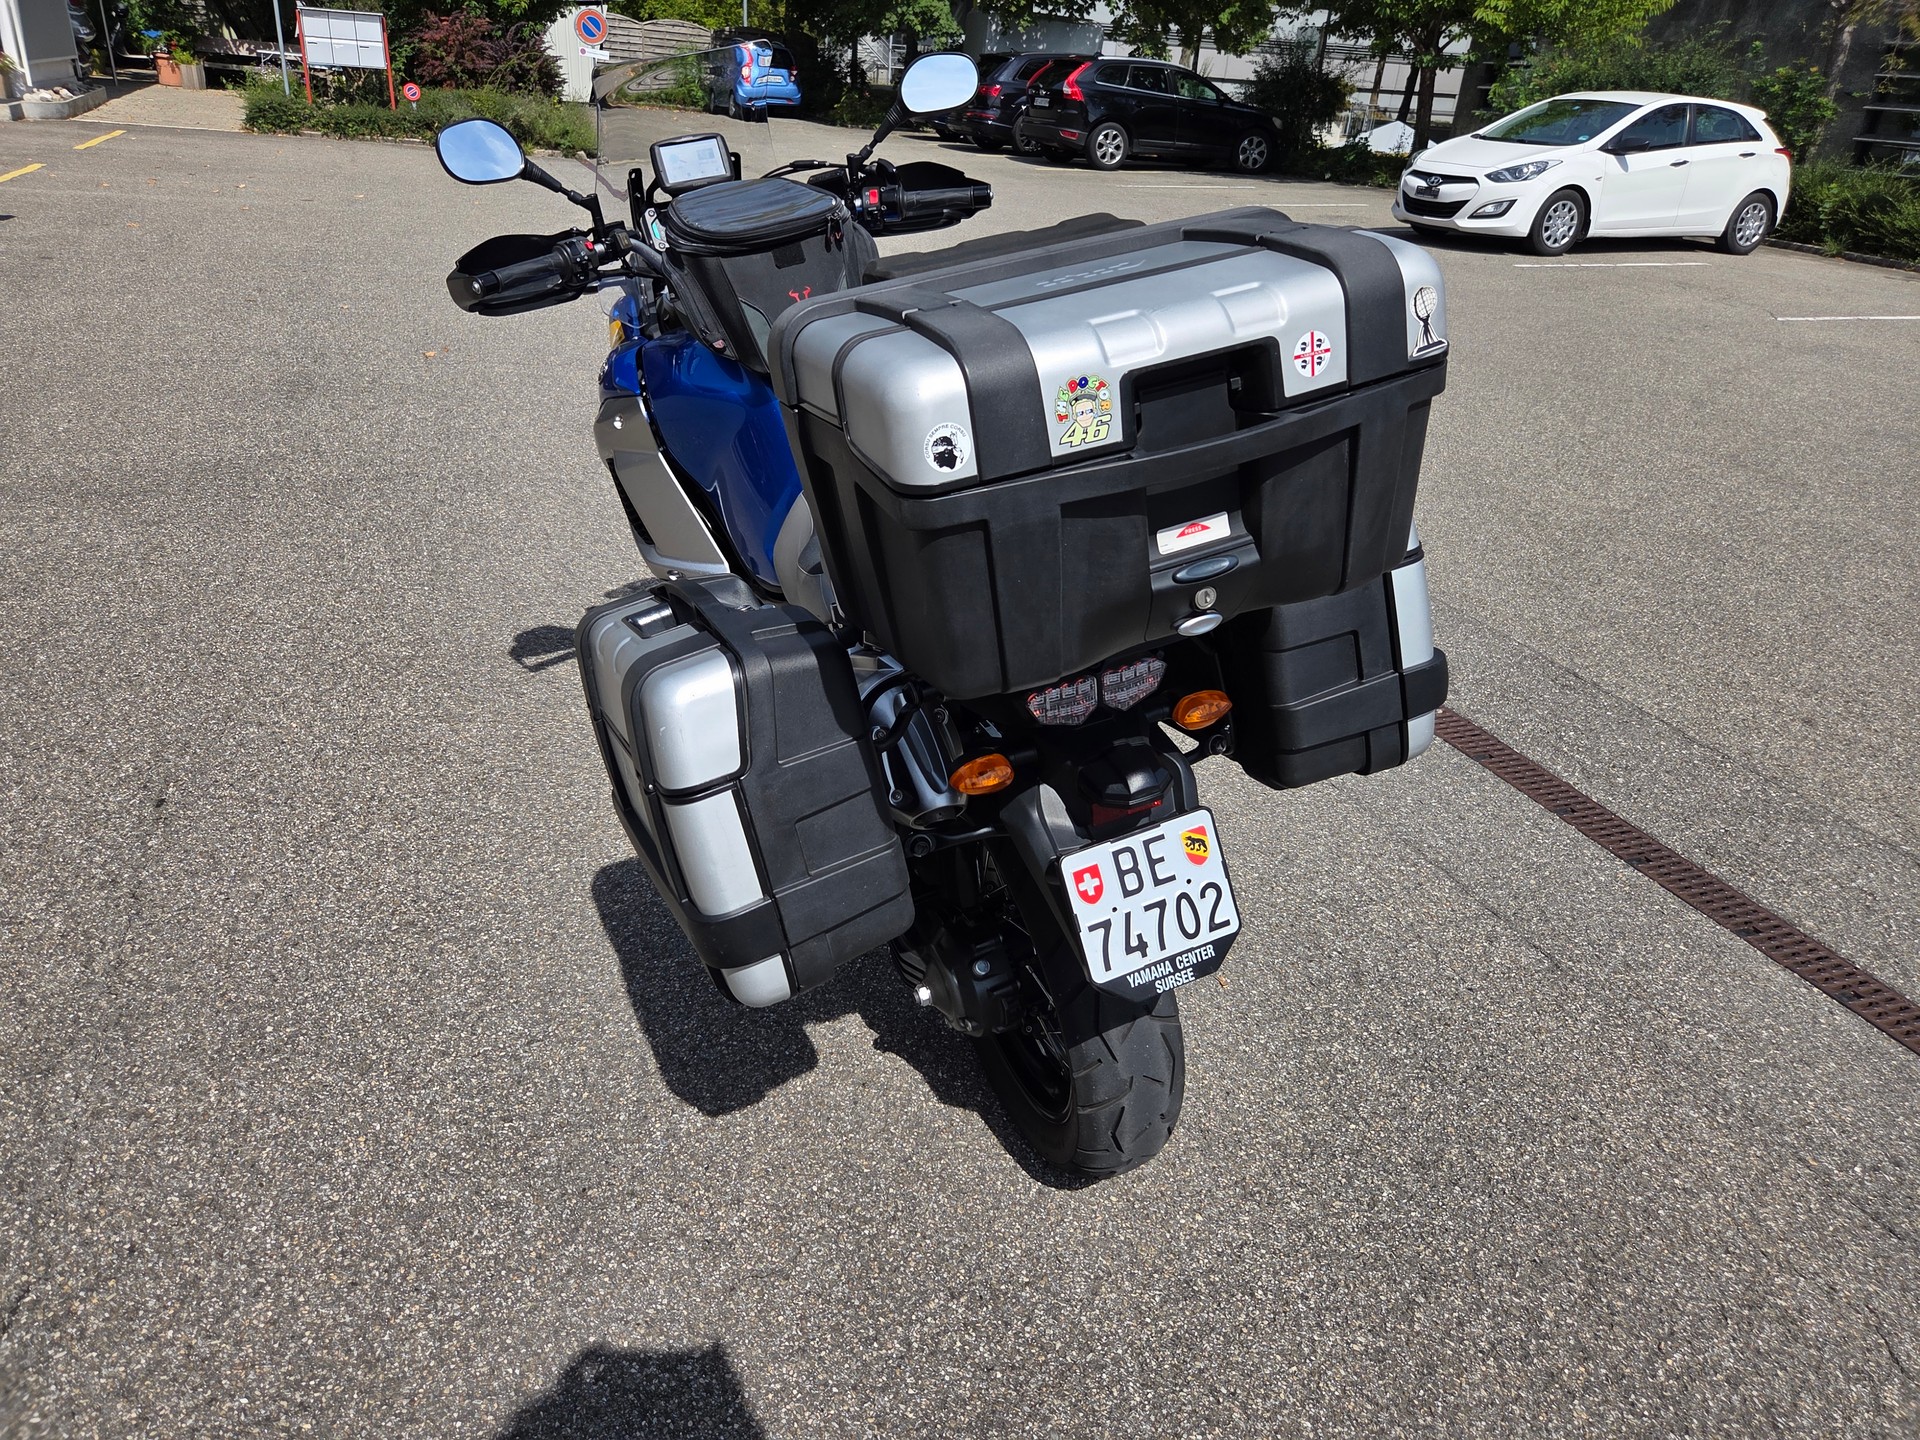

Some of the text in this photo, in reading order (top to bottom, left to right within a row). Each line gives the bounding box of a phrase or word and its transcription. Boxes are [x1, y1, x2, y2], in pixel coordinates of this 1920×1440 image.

[1067, 375, 1112, 412] DOCTOR
[1059, 413, 1112, 448] 46
[1184, 525, 1202, 535] PRESS
[1111, 833, 1177, 899] BE
[1087, 881, 1231, 973] 74702
[1126, 944, 1216, 989] YAMAHA CENTER
[1155, 967, 1196, 994] SURSEE
